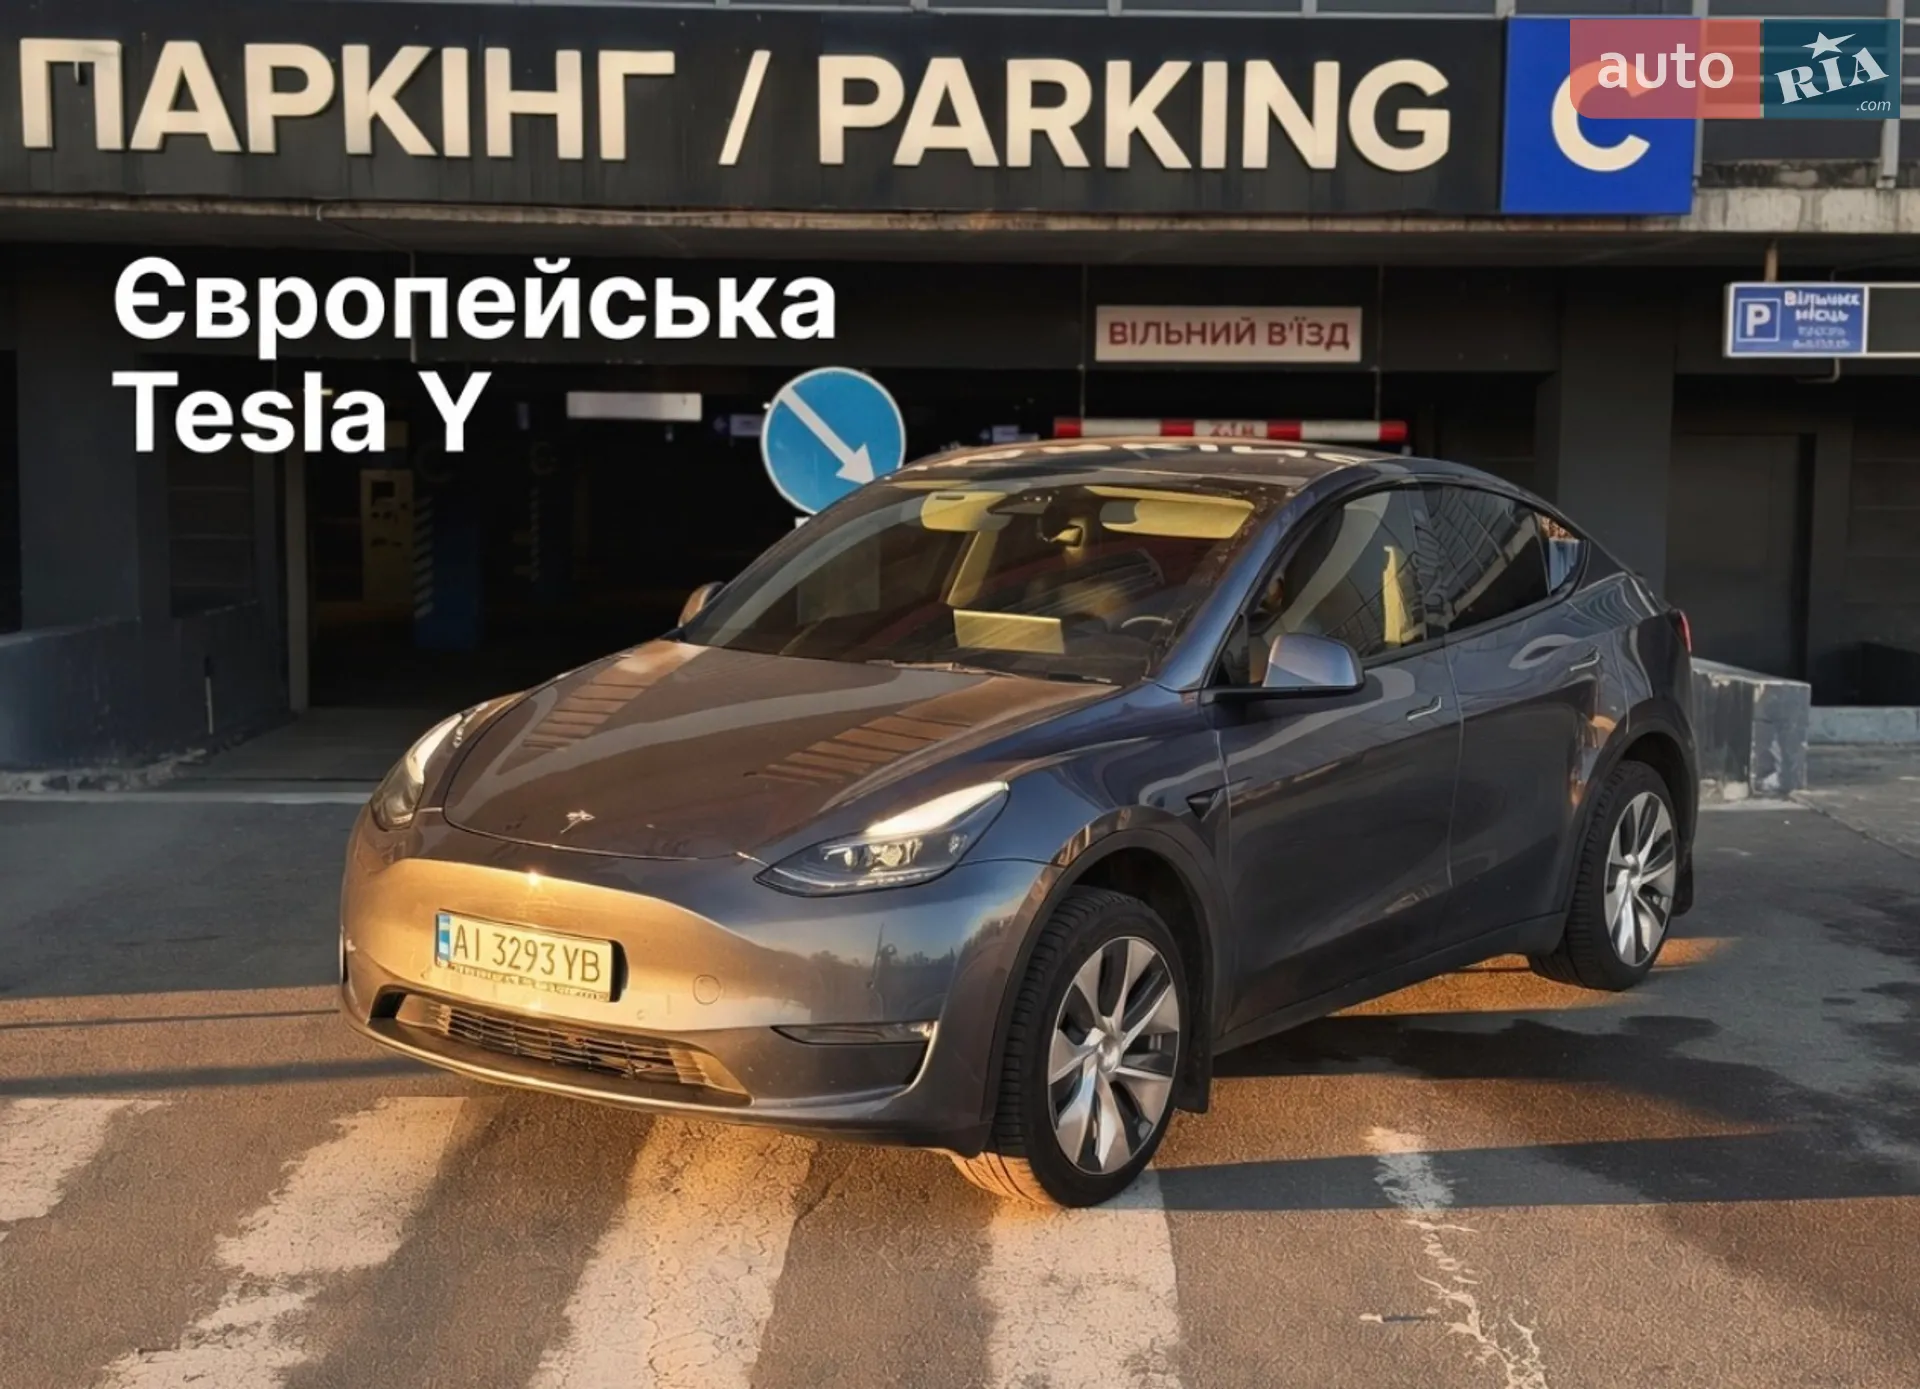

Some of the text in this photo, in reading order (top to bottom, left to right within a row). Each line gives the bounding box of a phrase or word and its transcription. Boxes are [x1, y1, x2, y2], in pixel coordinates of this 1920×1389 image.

[20, 38, 1450, 172] ПАРКІНГ / PARKING
[1109, 316, 1350, 350] ВІЛЬНИЙ В'ЇЗД
[1746, 303, 1771, 337] P
[452, 924, 480, 962] AI
[492, 932, 556, 976] 3293
[563, 945, 601, 983] YB
